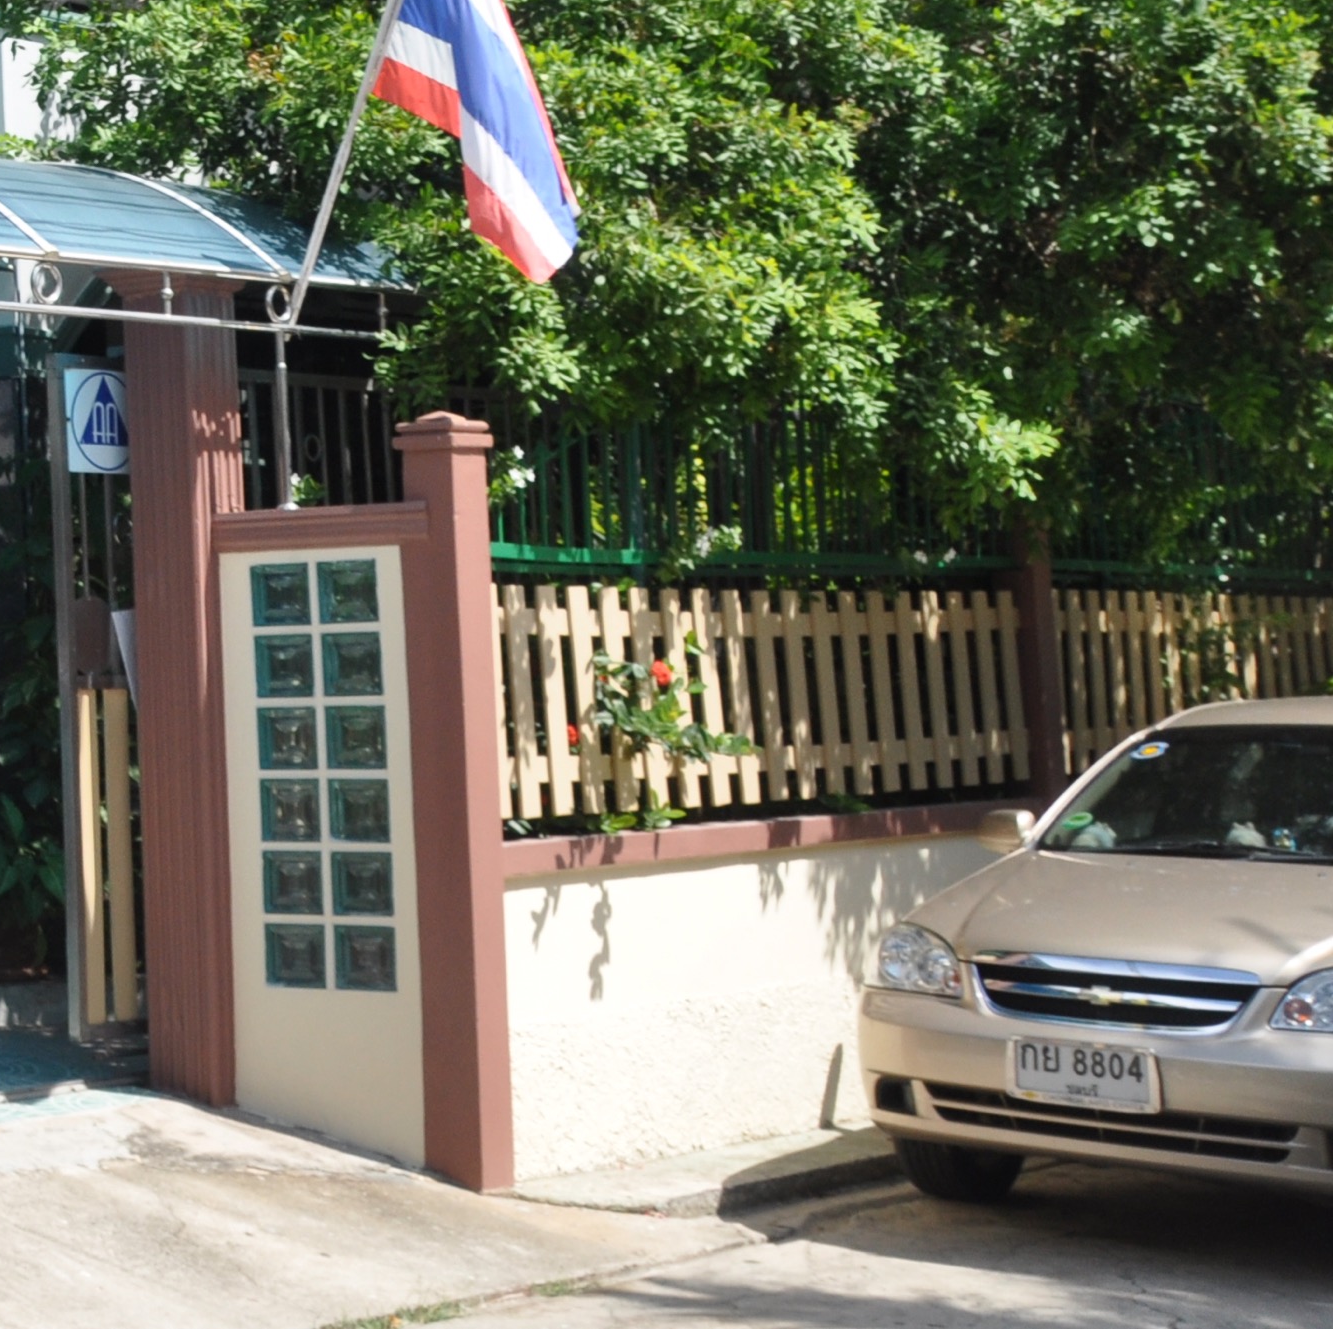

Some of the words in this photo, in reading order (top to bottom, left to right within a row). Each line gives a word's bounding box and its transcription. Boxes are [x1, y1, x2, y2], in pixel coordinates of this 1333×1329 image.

[93, 401, 119, 444] AA
[1021, 1043, 1060, 1072] กย
[1073, 1048, 1143, 1083] 8804
